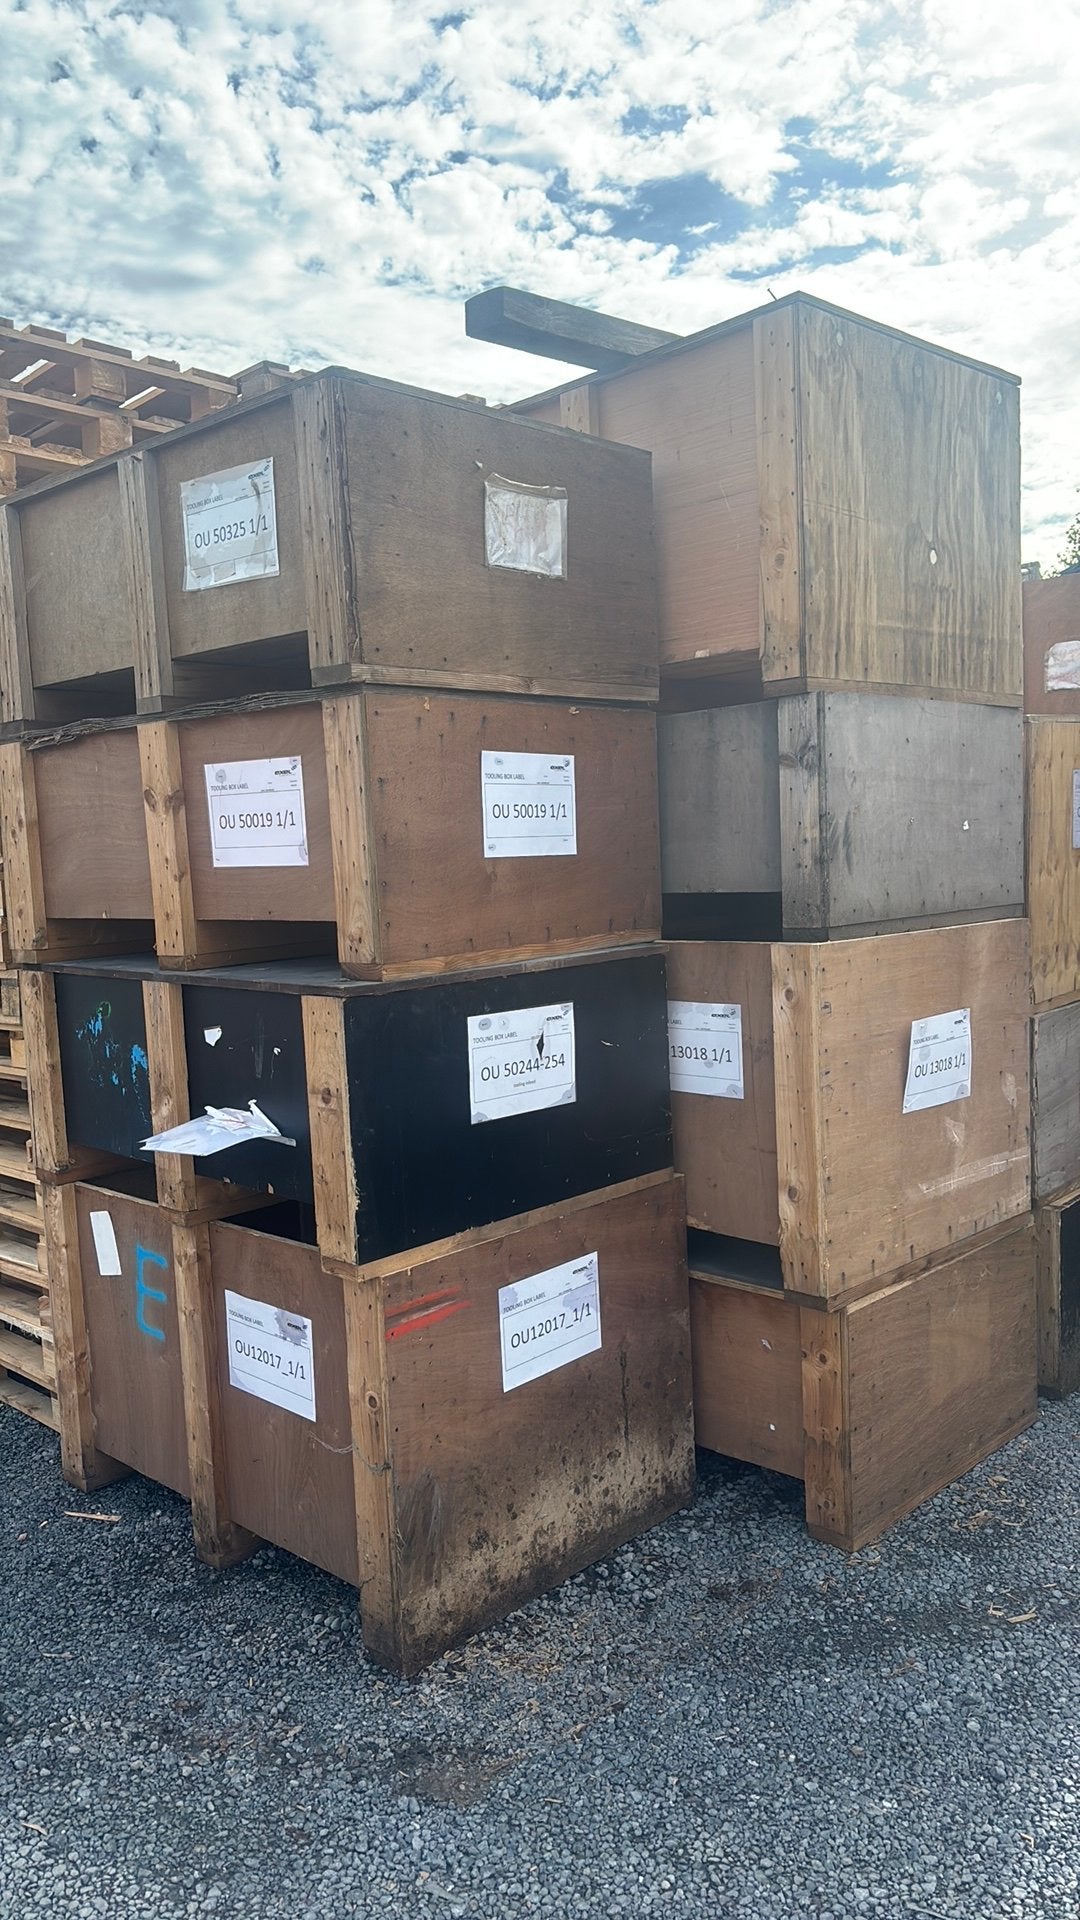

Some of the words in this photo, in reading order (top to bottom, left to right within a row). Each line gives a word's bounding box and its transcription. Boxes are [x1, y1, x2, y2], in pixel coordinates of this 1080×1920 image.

[195, 530, 210, 548] OU
[213, 521, 246, 544] 50325
[249, 514, 268, 536] 1/1
[220, 814, 236, 829] OU
[239, 812, 272, 828] 50019
[277, 809, 295, 829] 1/1
[492, 804, 510, 819] OU
[513, 804, 546, 819] 50019
[550, 802, 567, 820] 1/1
[473, 1035, 493, 1044] TOOLING
[505, 1031, 518, 1039] LABEL
[481, 1065, 500, 1081] OU
[504, 1053, 565, 1077] 50244-254
[671, 1045, 707, 1060] 13018
[712, 1048, 732, 1064] 1/1
[914, 1064, 928, 1078] OU
[930, 1057, 952, 1074] 13018
[954, 1052, 966, 1070] 1/1
[136, 1243, 168, 1342] E
[511, 1302, 591, 1349] OU12017_1/1
[235, 1339, 306, 1380] OU12017_1/1
